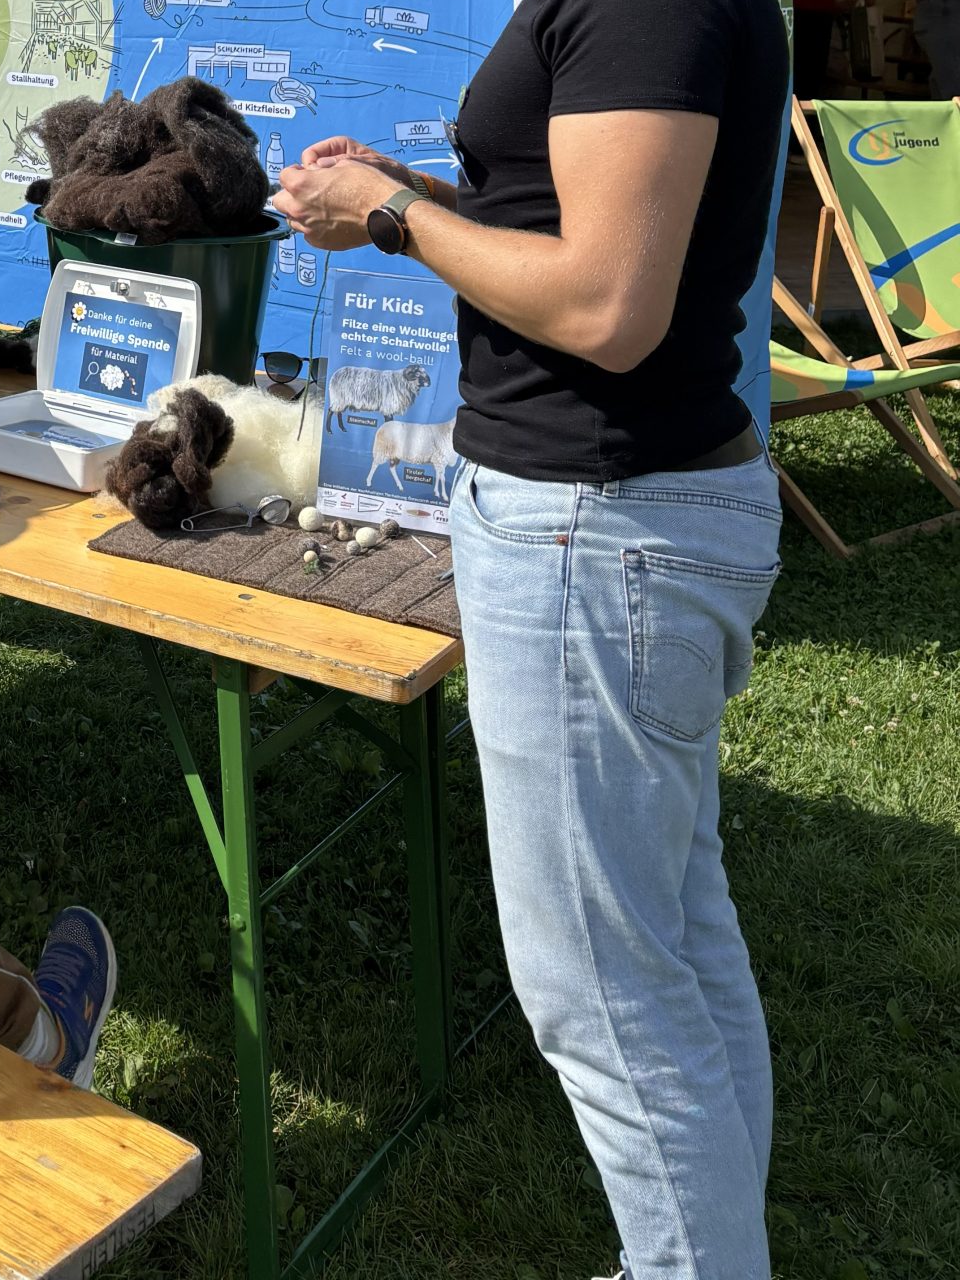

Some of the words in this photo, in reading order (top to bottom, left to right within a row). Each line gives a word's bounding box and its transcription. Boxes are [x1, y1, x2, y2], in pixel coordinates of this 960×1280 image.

[217, 45, 263, 54] SCHLACHTHOF
[11, 74, 54, 87] Stallhaltung
[245, 102, 291, 115] Kitzfleisch
[894, 136, 939, 148] jugend
[344, 292, 377, 310] Für
[381, 296, 424, 316] Kids
[88, 310, 113, 322] Danke
[115, 314, 127, 325] für
[129, 318, 153, 330] deine
[342, 318, 369, 331] Filze
[371, 322, 397, 334] eine
[399, 324, 458, 342] Wollkugel
[70, 322, 125, 344] Freiwillige
[127, 333, 171, 352] Spende
[341, 331, 378, 344] echter
[381, 335, 450, 353] Schafwolle!
[91, 346, 103, 357] für
[104, 349, 138, 365] Material
[340, 345, 362, 358] Felt
[366, 350, 372, 358] a
[376, 349, 434, 366] wool-ball!
